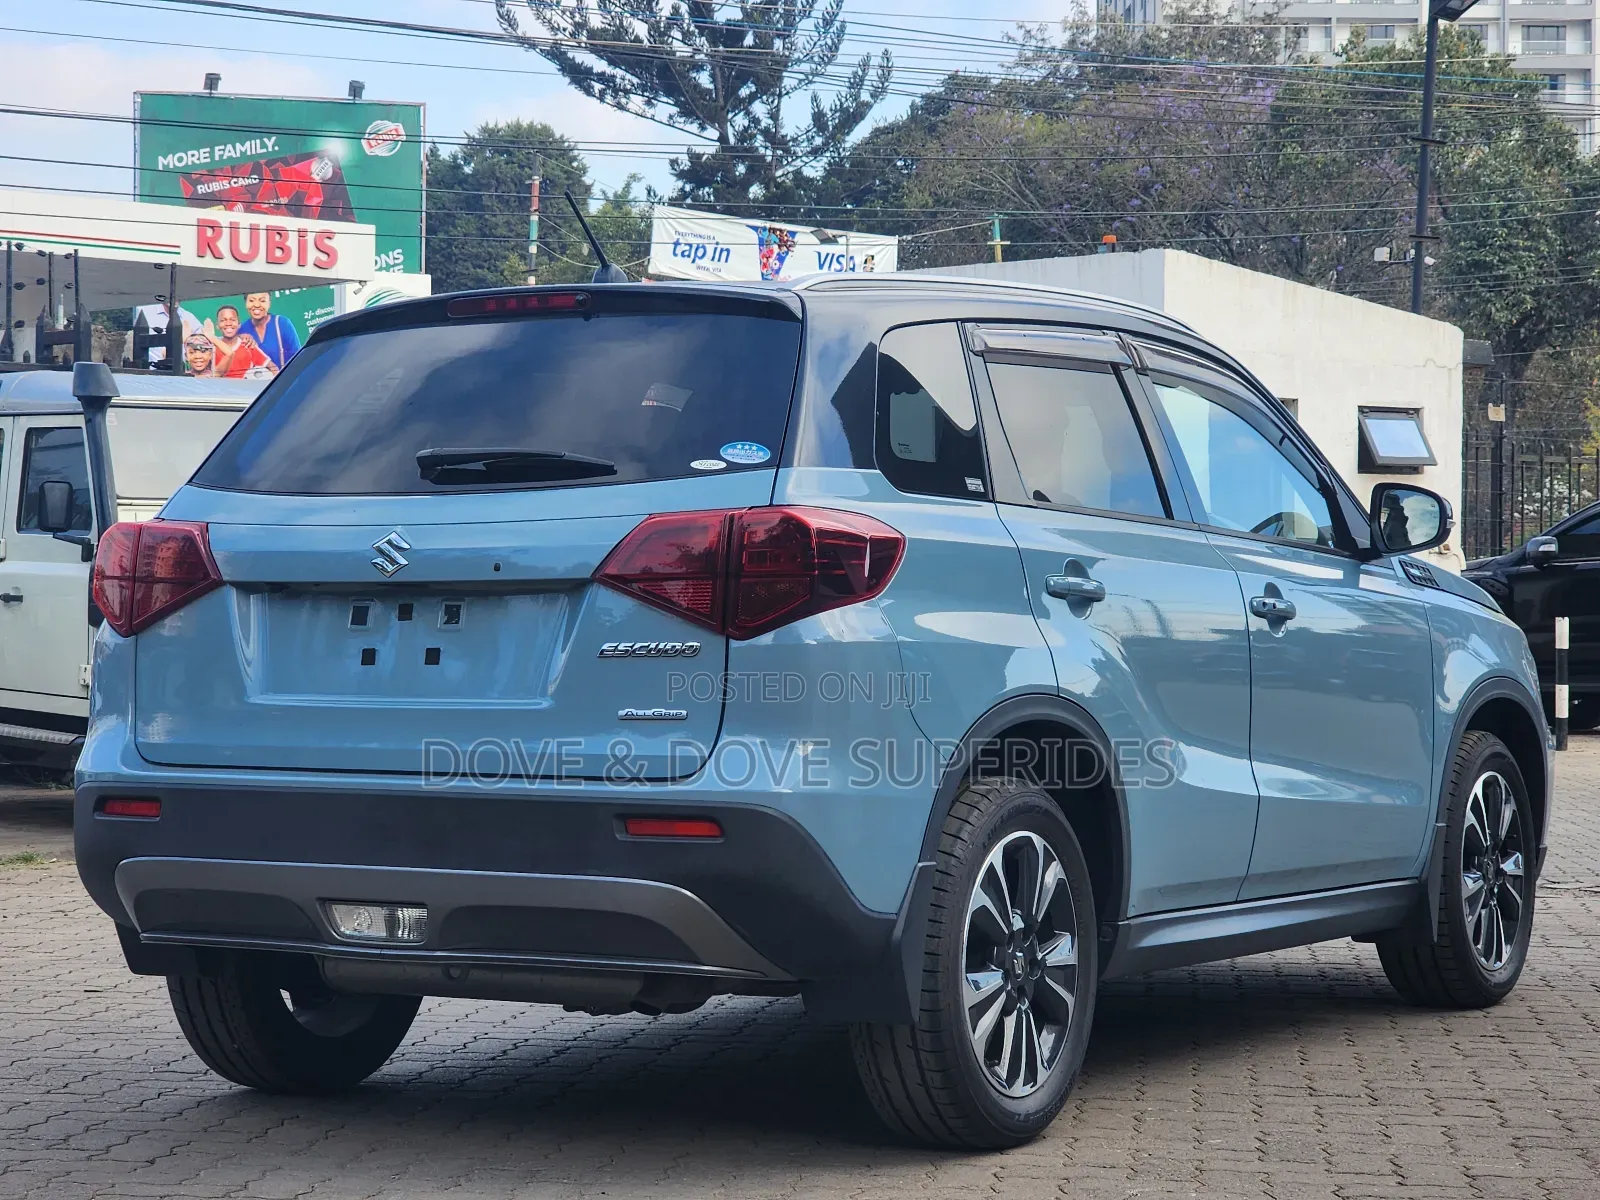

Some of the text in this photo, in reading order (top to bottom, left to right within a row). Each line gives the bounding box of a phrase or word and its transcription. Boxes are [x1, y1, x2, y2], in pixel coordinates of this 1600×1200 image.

[158, 136, 279, 170] MORE FAMILY.
[230, 175, 260, 188] CARD
[672, 238, 731, 264] tap in
[814, 251, 856, 272] VISA
[597, 642, 701, 658] ESCUDO
